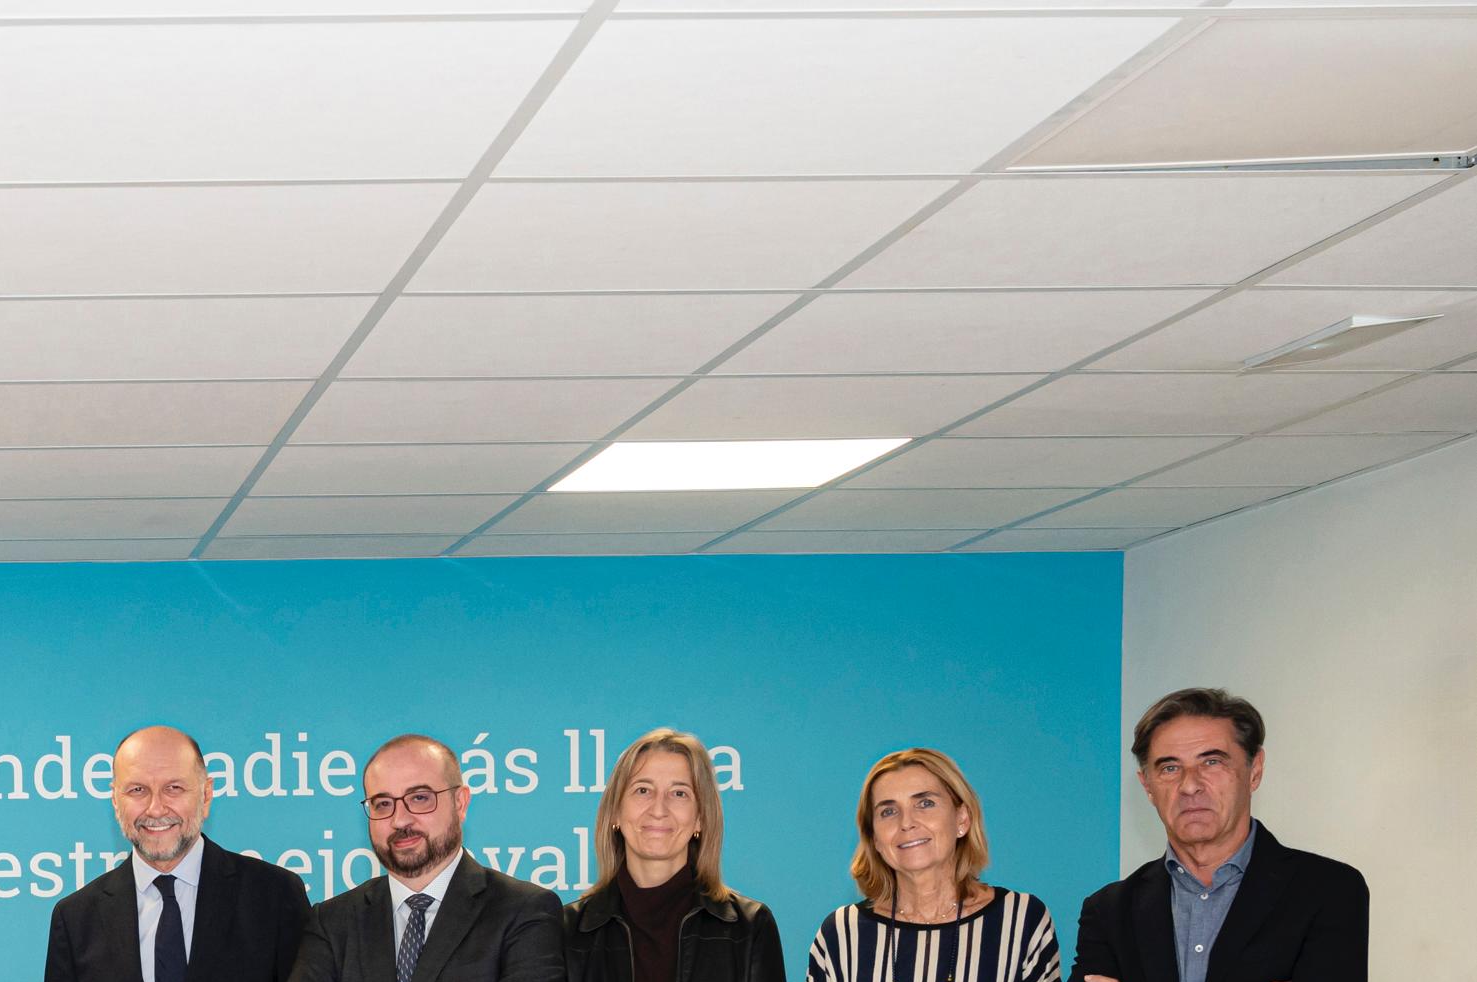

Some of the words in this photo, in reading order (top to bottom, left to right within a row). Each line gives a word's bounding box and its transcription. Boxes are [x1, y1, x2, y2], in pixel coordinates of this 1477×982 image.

[205, 732, 356, 797] adie
[564, 729, 744, 793] lla
[240, 830, 381, 901] ejo
[465, 826, 593, 891] val
